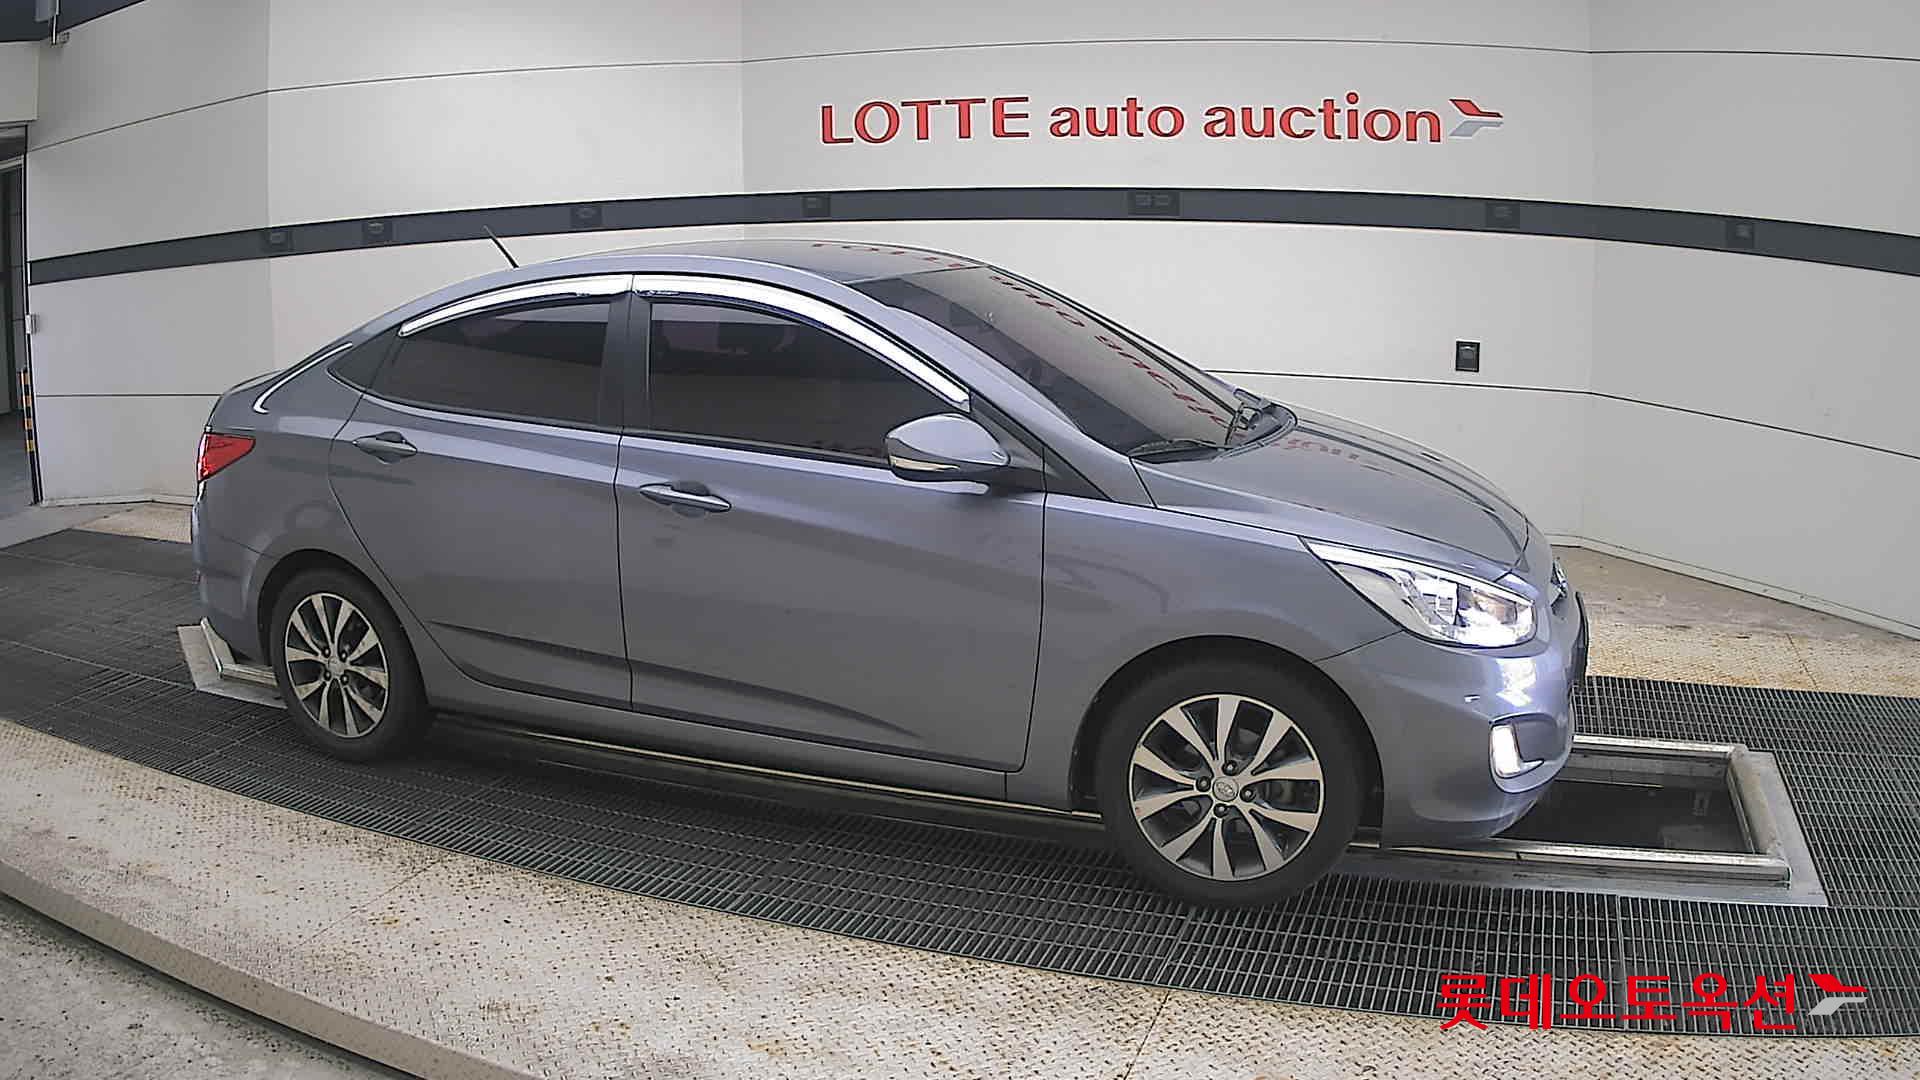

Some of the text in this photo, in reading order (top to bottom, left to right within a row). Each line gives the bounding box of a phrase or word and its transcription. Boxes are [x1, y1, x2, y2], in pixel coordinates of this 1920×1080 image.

[820, 91, 1442, 145] LOTTE auto auction
